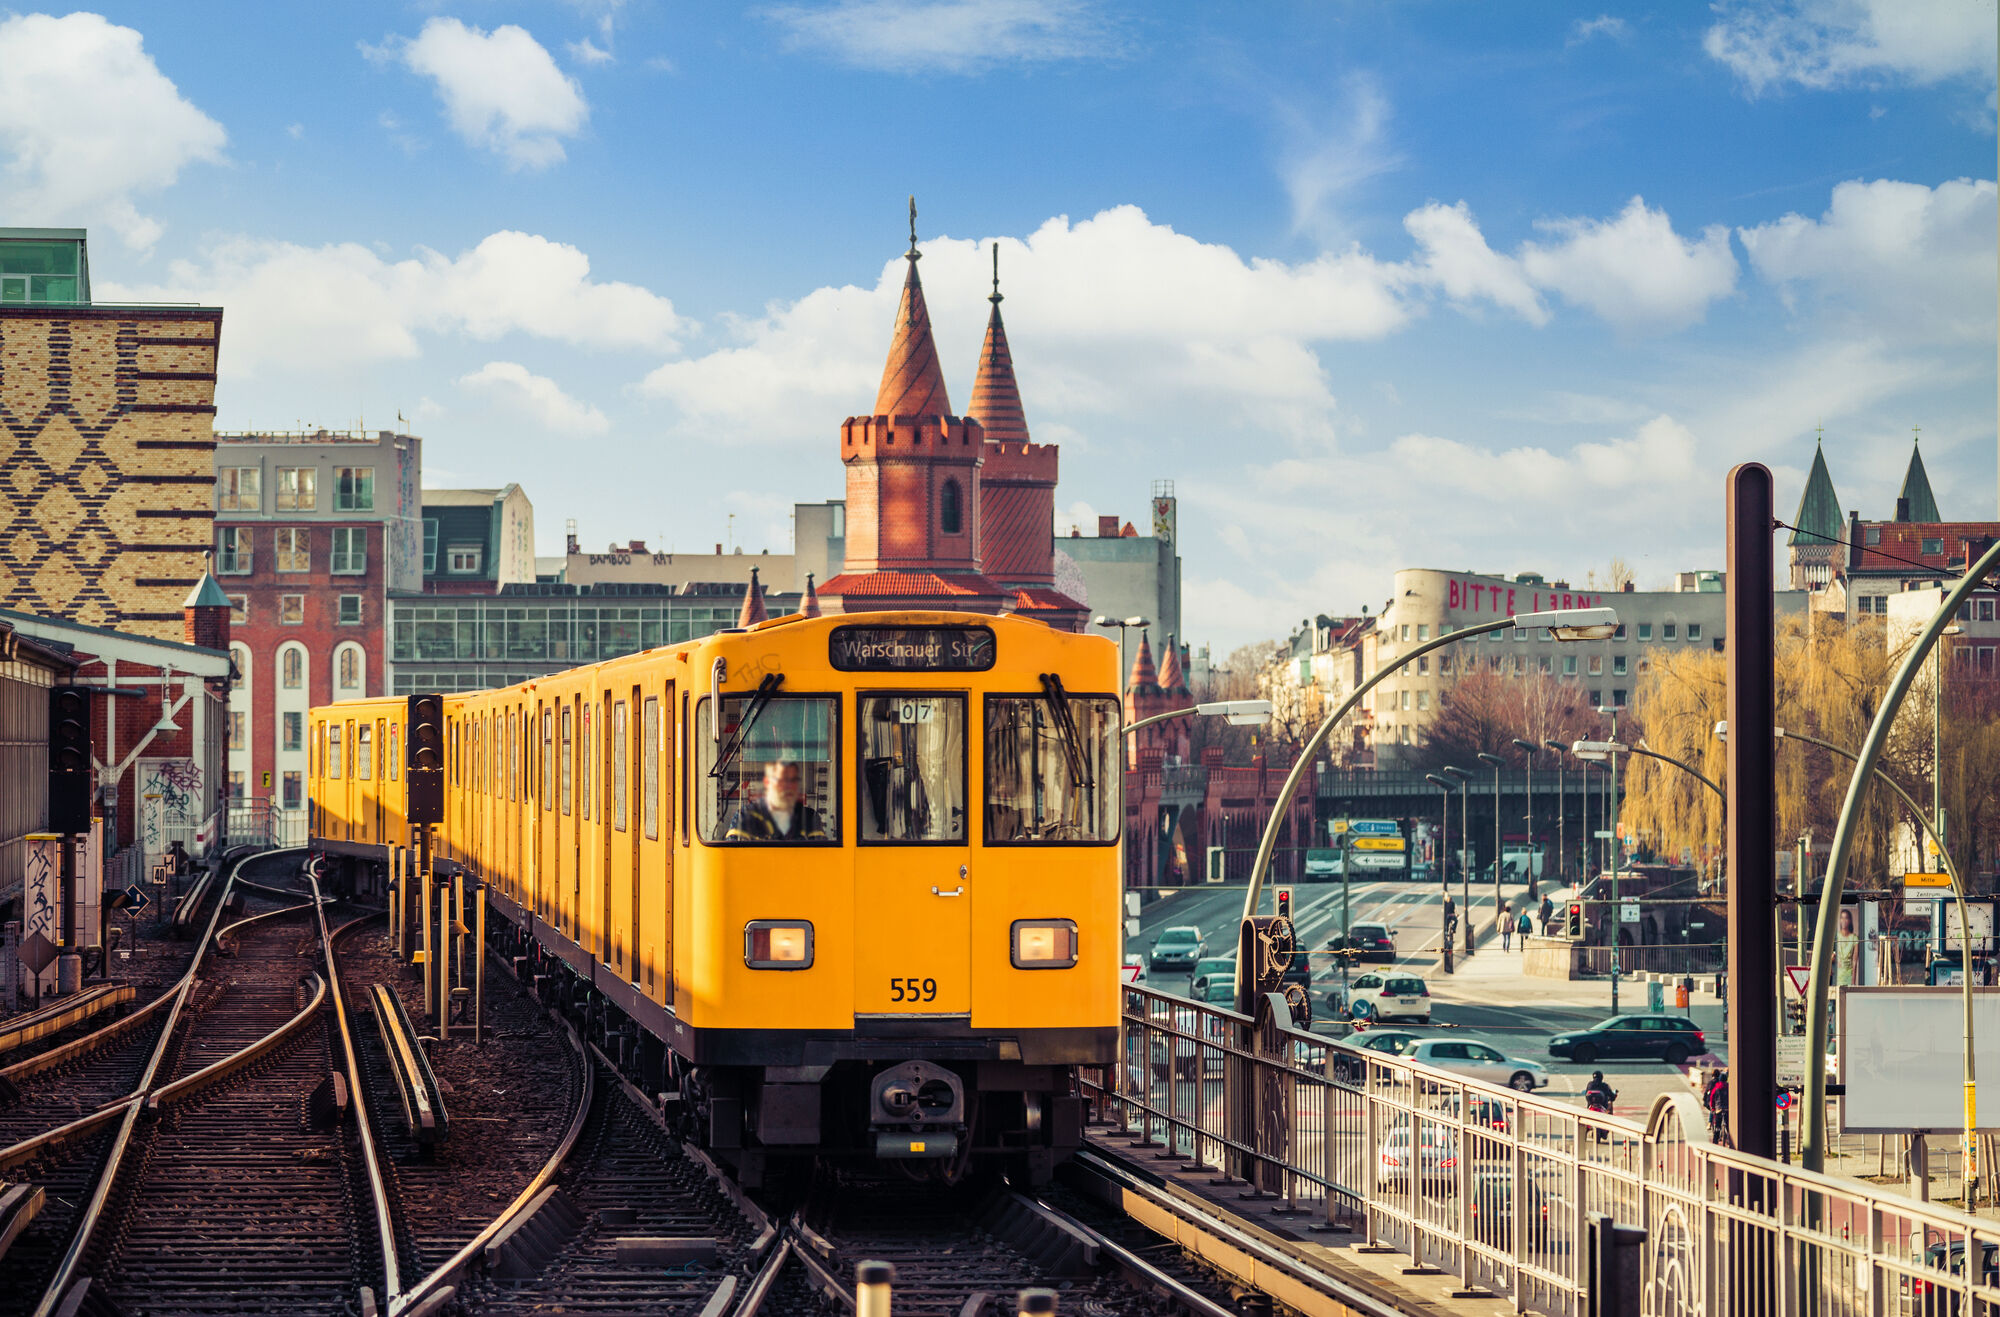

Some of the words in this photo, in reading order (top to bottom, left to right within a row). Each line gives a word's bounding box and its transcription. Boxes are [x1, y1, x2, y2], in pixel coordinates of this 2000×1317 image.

[590, 554, 631, 566] BAMBOO
[653, 554, 673, 566] RAT
[1449, 579, 1516, 617] BITTE
[845, 640, 942, 657] Warschauer
[952, 641, 978, 657] Str.
[263, 773, 269, 785] F
[155, 868, 164, 882] 40
[890, 977, 937, 1002] 559
